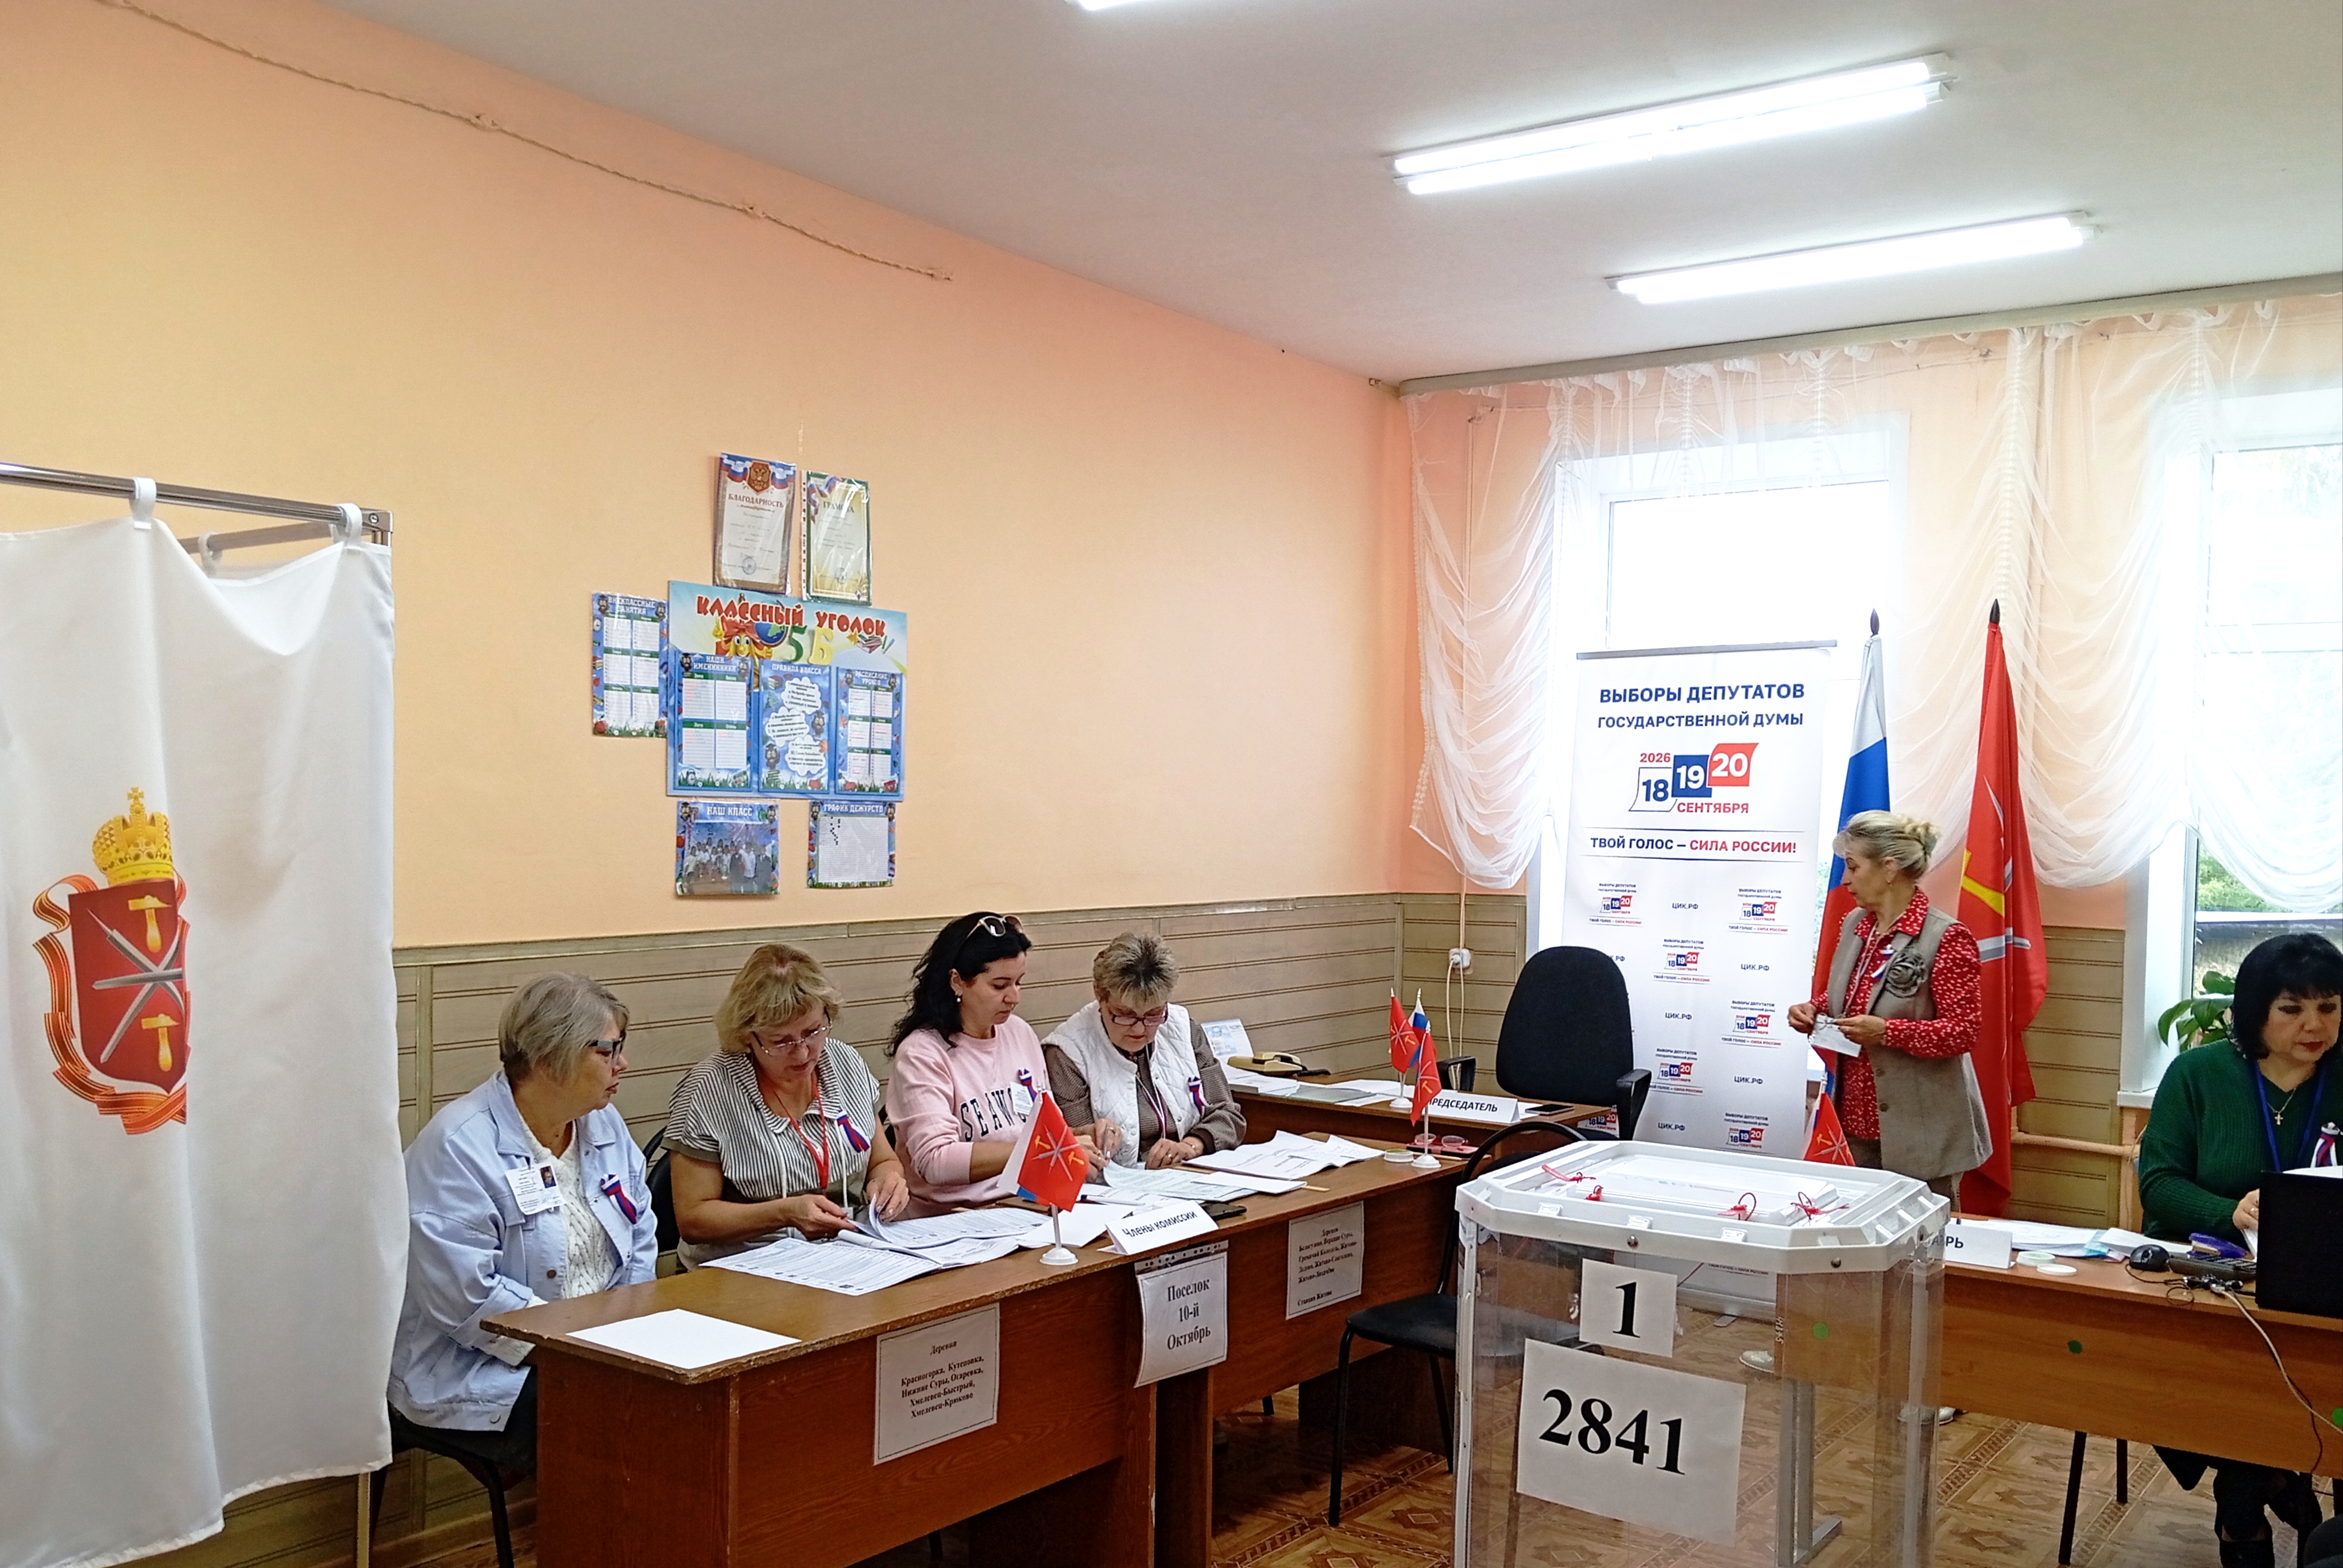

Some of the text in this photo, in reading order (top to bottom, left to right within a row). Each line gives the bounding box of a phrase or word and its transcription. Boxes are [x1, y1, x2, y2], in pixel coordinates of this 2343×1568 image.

[728, 493, 784, 508] БЛАГОДАРНОСТЬ
[697, 595, 886, 636] КЛАССНЫЙ УГОЛОК
[788, 626, 833, 665] 5 Б
[694, 663, 736, 672] ИМЕНИННИКИ
[772, 664, 798, 672] ПРАВИЛА
[1599, 683, 1805, 703] ВЫБОРЫ ДЕПУТАТОВ
[1598, 711, 1803, 729] ГОСУДАРСТВЕННОЙ ДУМЫ
[1640, 752, 1671, 763] 2026
[1642, 752, 1748, 802] 18 19 20
[707, 807, 752, 816] НАШ КЛАСС
[823, 804, 849, 812] ГРАФИК
[1677, 802, 1749, 814] СЕНТЯБРЯ
[1590, 835, 1626, 850] ТВОЙ
[1629, 838, 1673, 850] ГОЛОС
[1689, 839, 1729, 851] СИЛА
[1732, 841, 1797, 853] РОССИИ!
[1658, 1123, 1685, 1131] ЦИК.РФ
[1122, 1211, 1198, 1238] Члены комиссии
[1167, 1279, 1210, 1302] Поселок
[1178, 1302, 1199, 1322] 10-й
[1613, 1281, 1640, 1338] 1
[1167, 1325, 1211, 1350] Октябрь
[930, 1341, 957, 1355] Деревни
[1538, 1389, 1685, 1475] 2841
